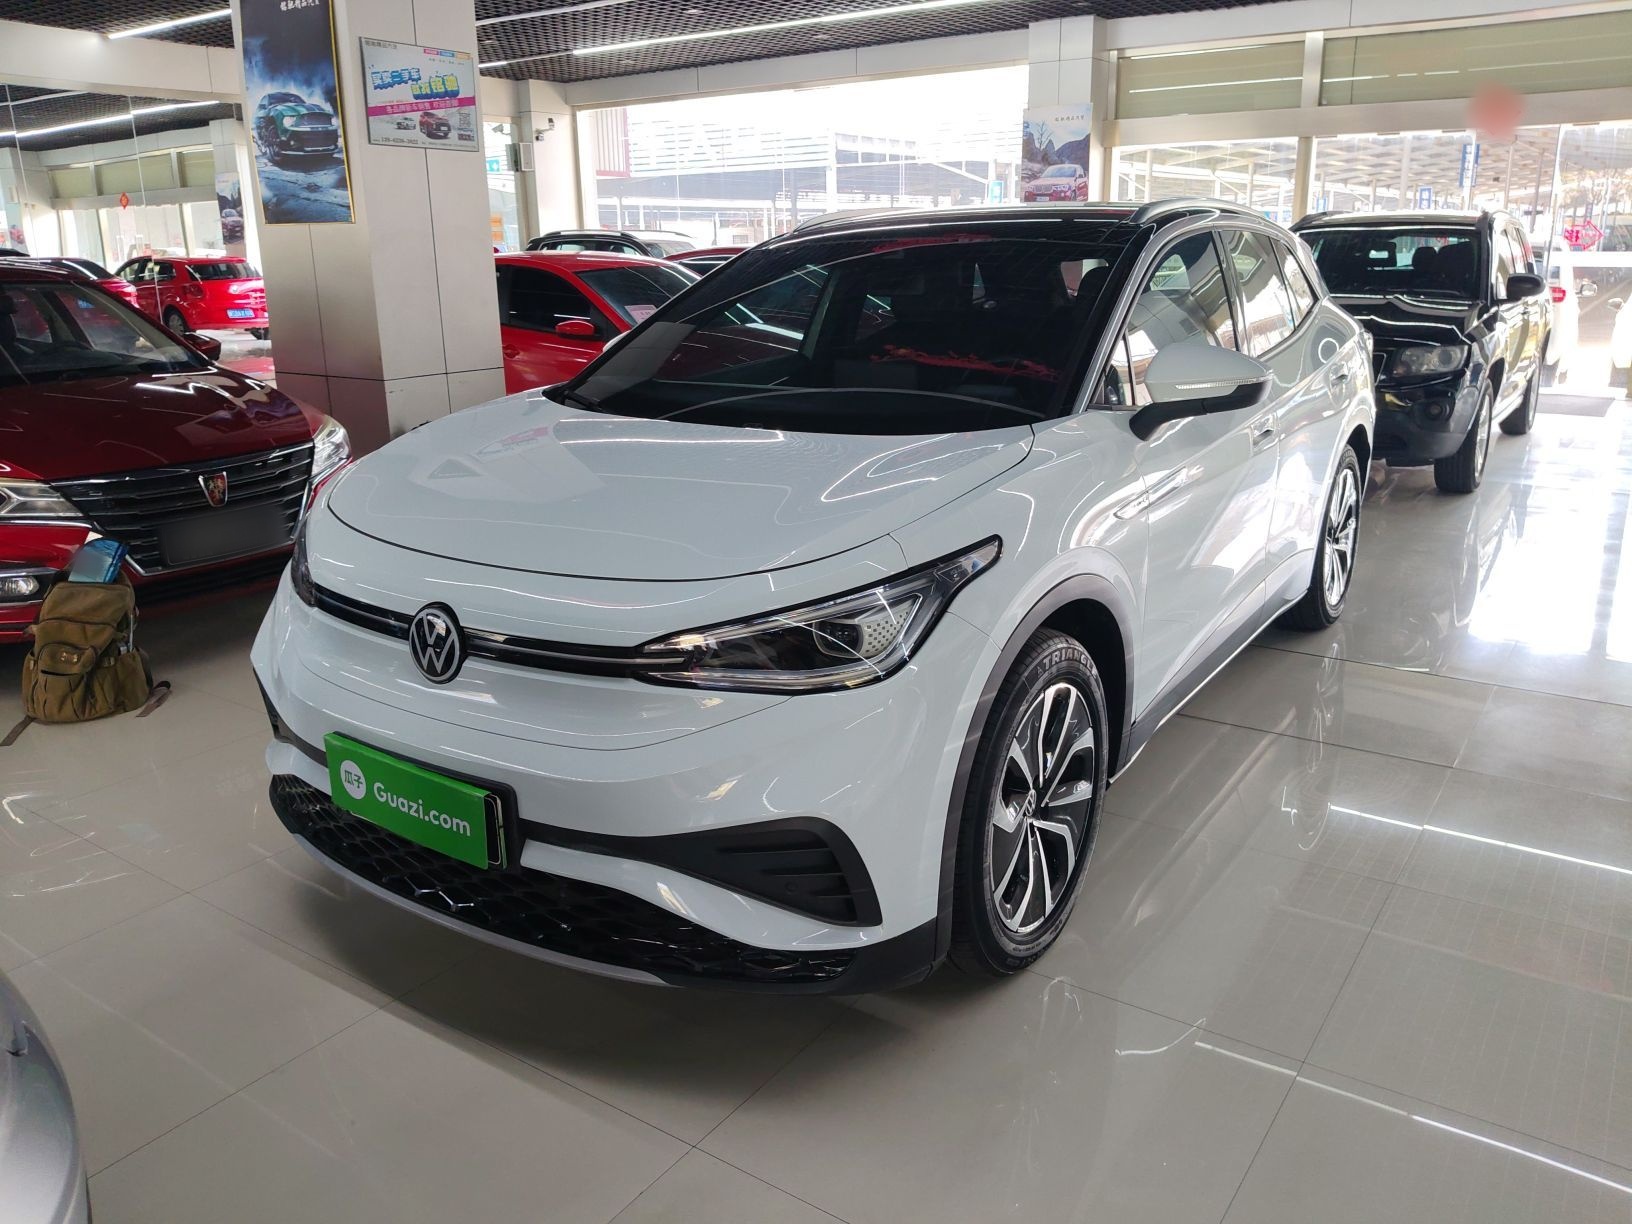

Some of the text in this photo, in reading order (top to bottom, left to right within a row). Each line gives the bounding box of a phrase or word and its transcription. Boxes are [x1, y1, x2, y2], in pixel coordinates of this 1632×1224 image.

[1043, 649, 1097, 678] TRIANGLE
[344, 769, 363, 789] 瓜子
[374, 782, 471, 837] Guazi.com
